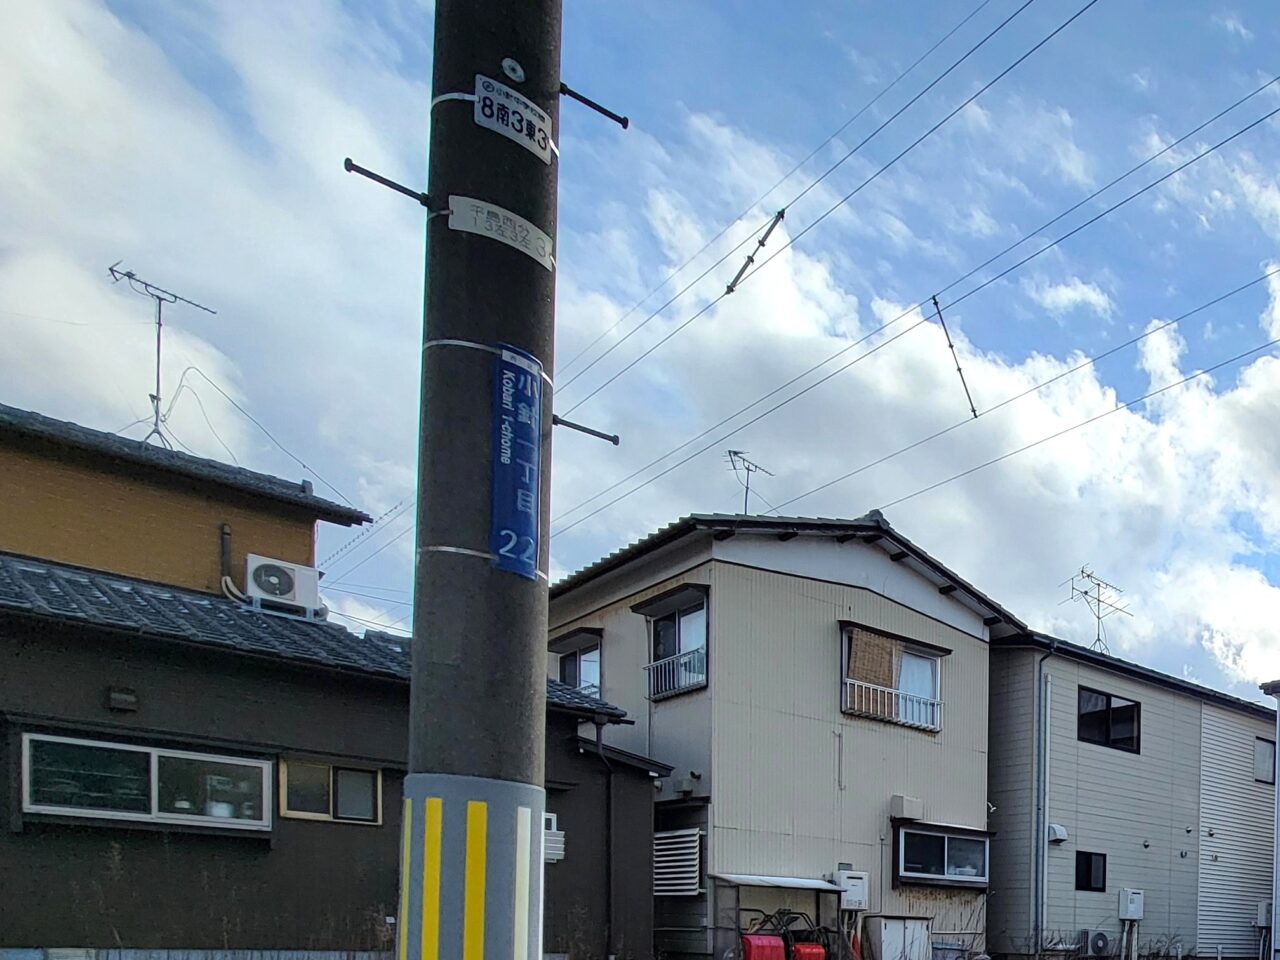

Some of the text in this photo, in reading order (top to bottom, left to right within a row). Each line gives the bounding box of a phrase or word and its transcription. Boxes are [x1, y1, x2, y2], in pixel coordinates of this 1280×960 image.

[481, 96, 548, 151] 8南3東3
[500, 370, 516, 464] Kobari 1-chome
[498, 529, 535, 565] 22
